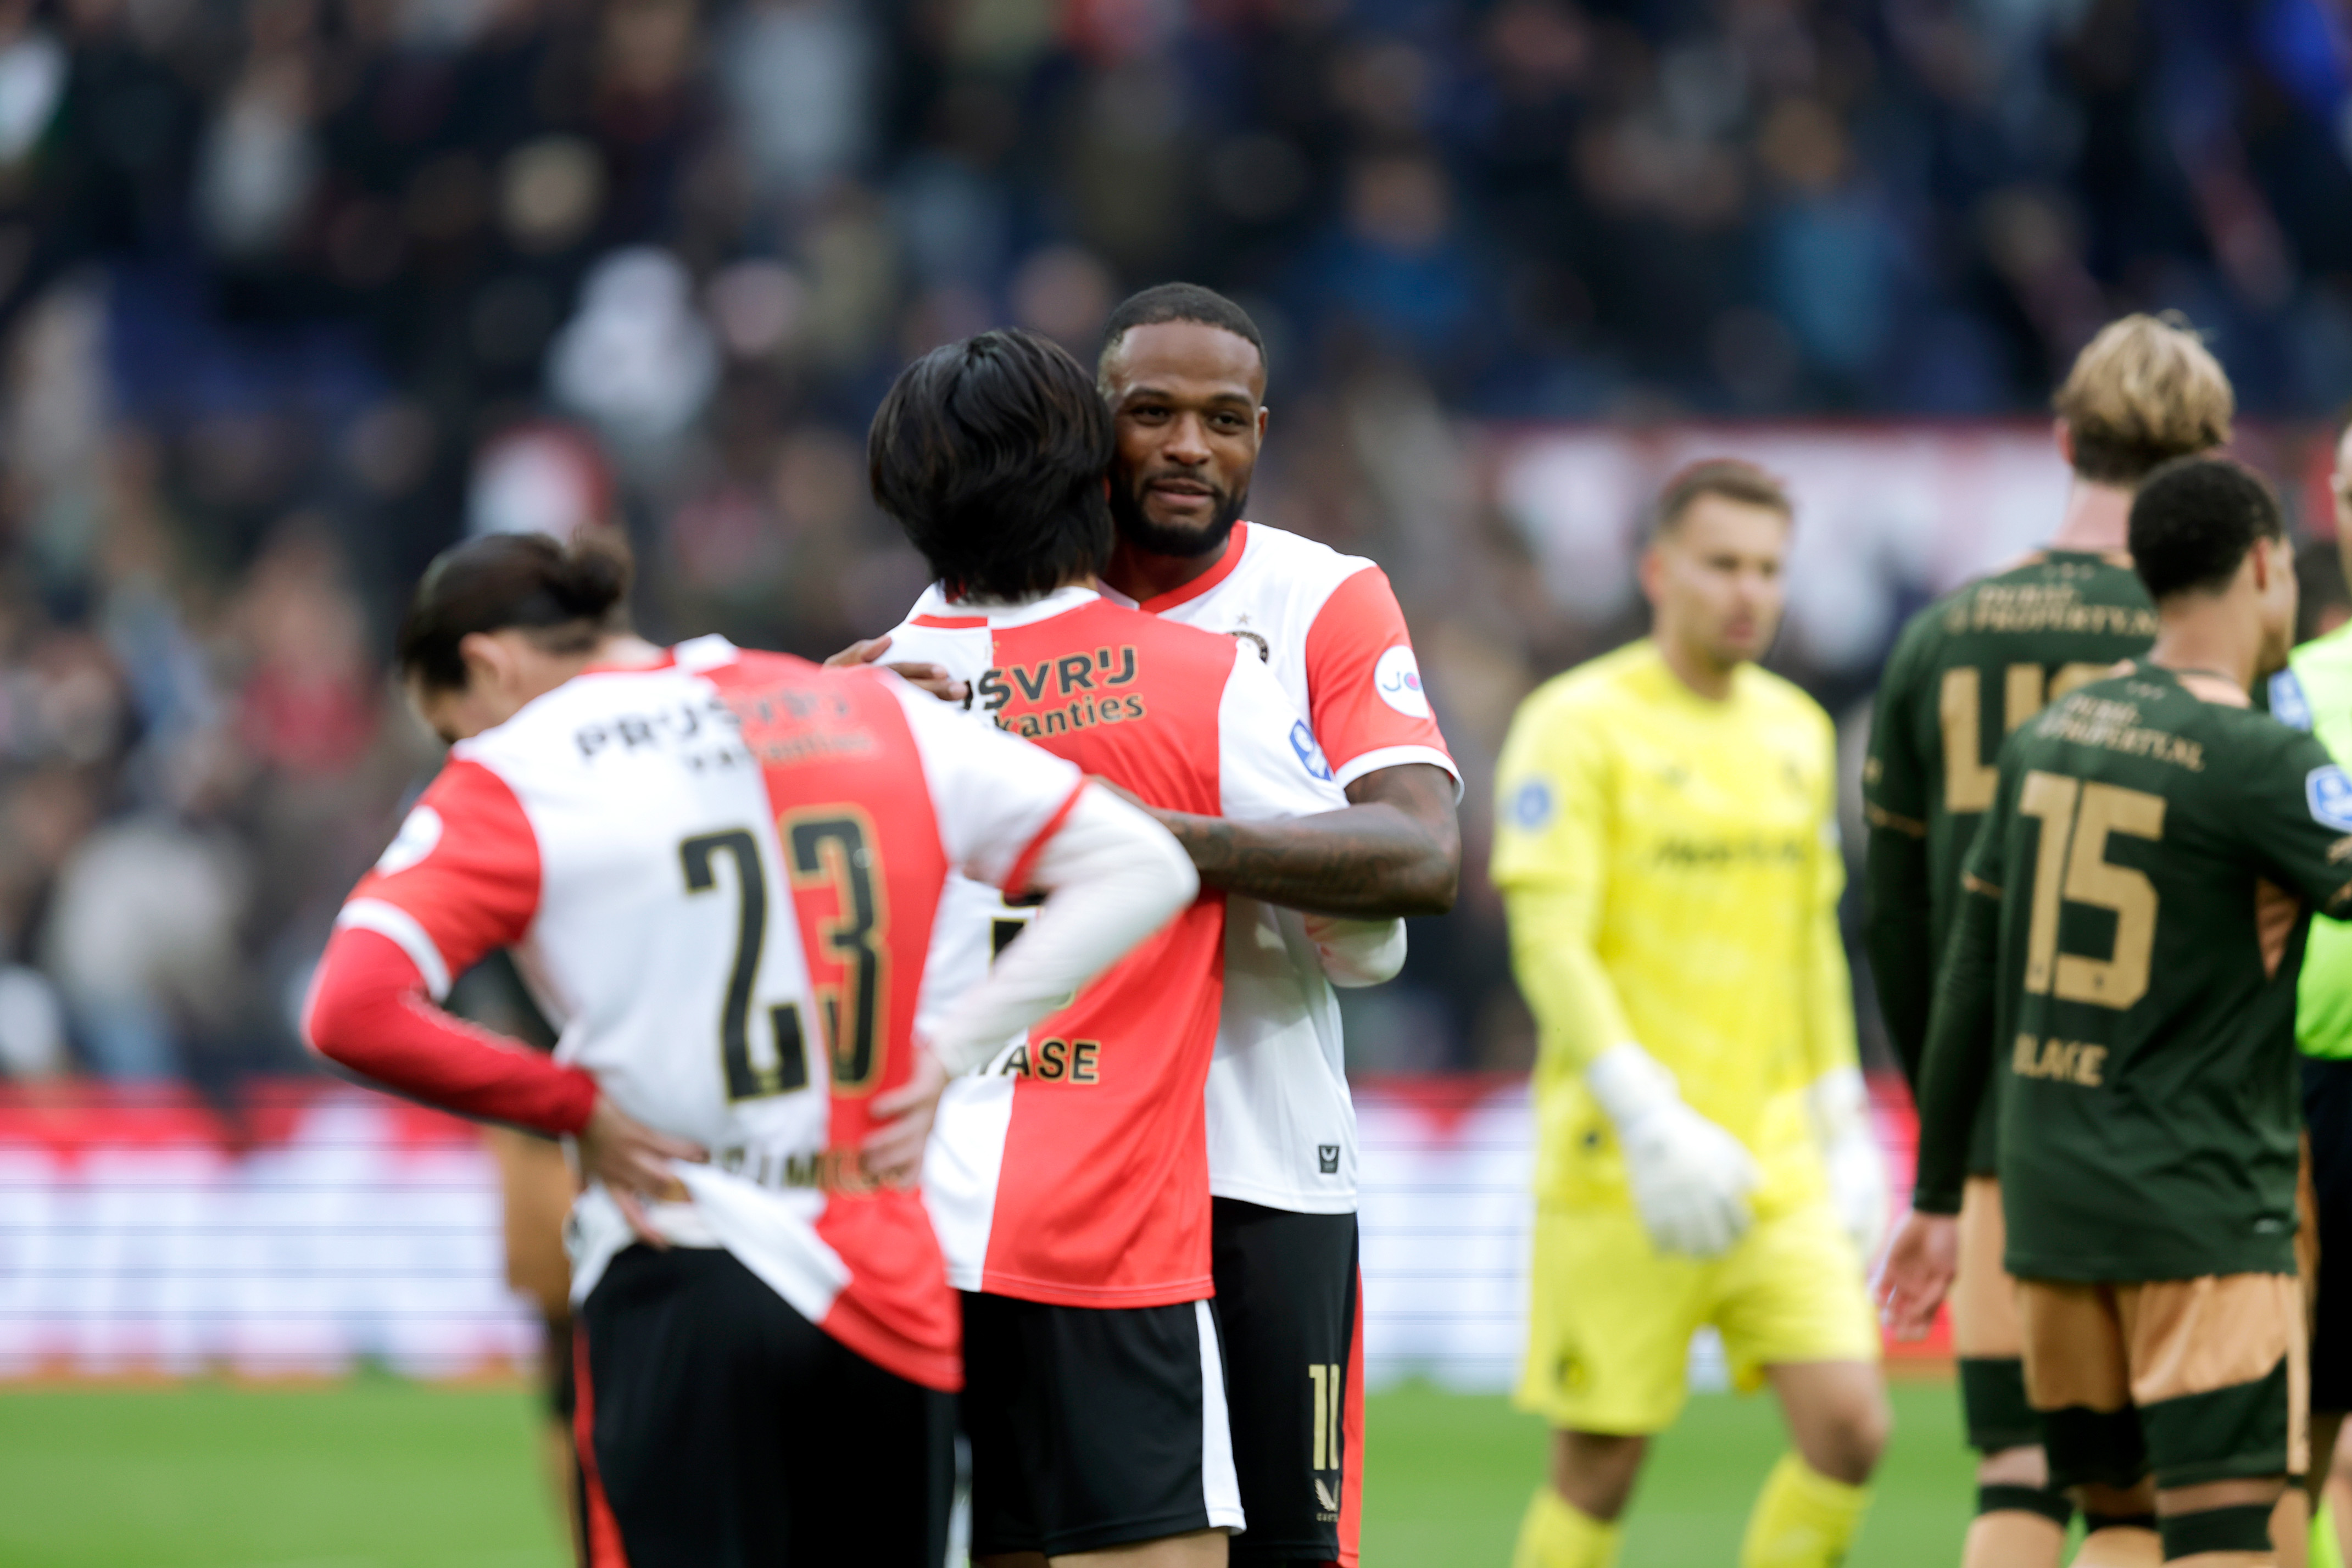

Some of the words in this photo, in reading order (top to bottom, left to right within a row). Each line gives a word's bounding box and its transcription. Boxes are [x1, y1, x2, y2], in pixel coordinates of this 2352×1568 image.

[679, 802, 892, 1102] 23
[2019, 770, 2168, 1011] 15
[978, 1038, 1100, 1084] ASE
